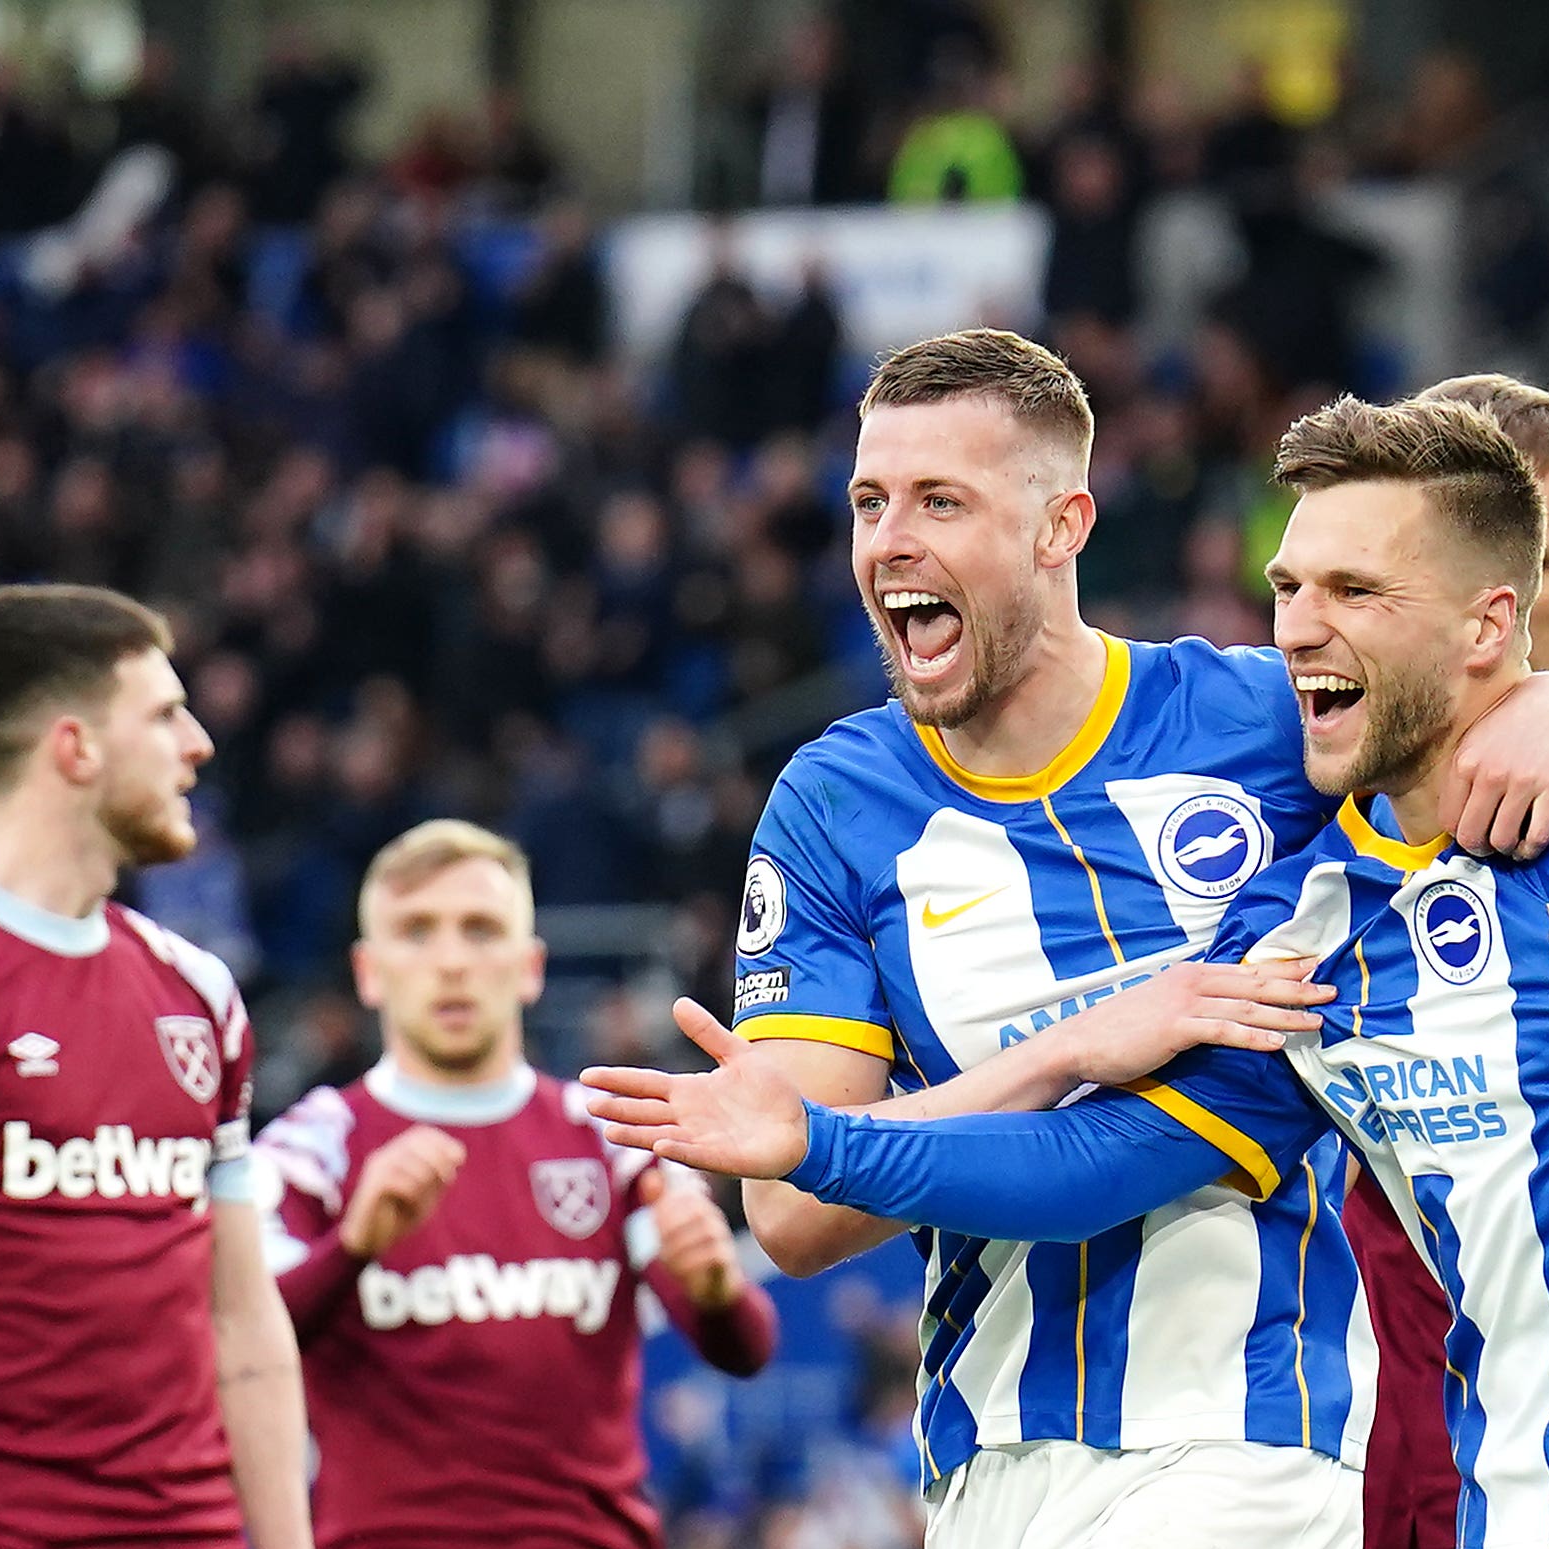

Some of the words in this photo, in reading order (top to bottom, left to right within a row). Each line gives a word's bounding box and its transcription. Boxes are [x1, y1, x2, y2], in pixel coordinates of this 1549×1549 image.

[1165, 801, 1201, 840] BRIGHTON
[1217, 800, 1242, 814] HOVE
[1205, 876, 1242, 893] ALBION
[358, 1253, 620, 1336] betway
